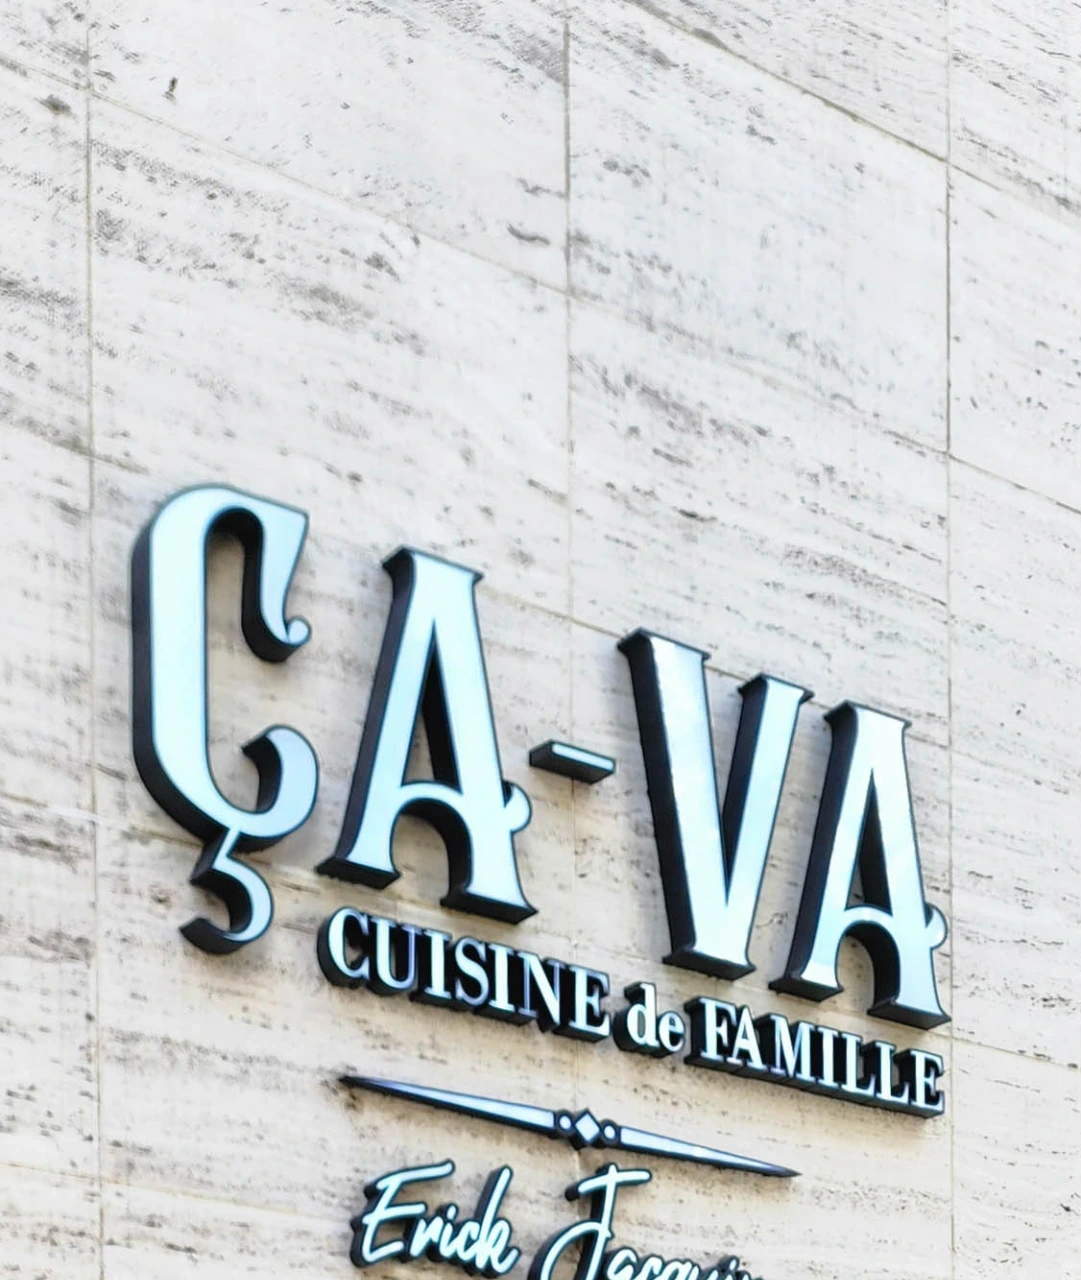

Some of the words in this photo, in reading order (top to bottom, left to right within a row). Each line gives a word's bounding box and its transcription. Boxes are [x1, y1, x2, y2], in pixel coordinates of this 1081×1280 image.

[131, 483, 952, 1029] ÇA-VA
[317, 906, 610, 1042] CUISINE
[614, 981, 685, 1058] de
[686, 996, 945, 1118] FAMILLE
[350, 1159, 520, 1277] Erick
